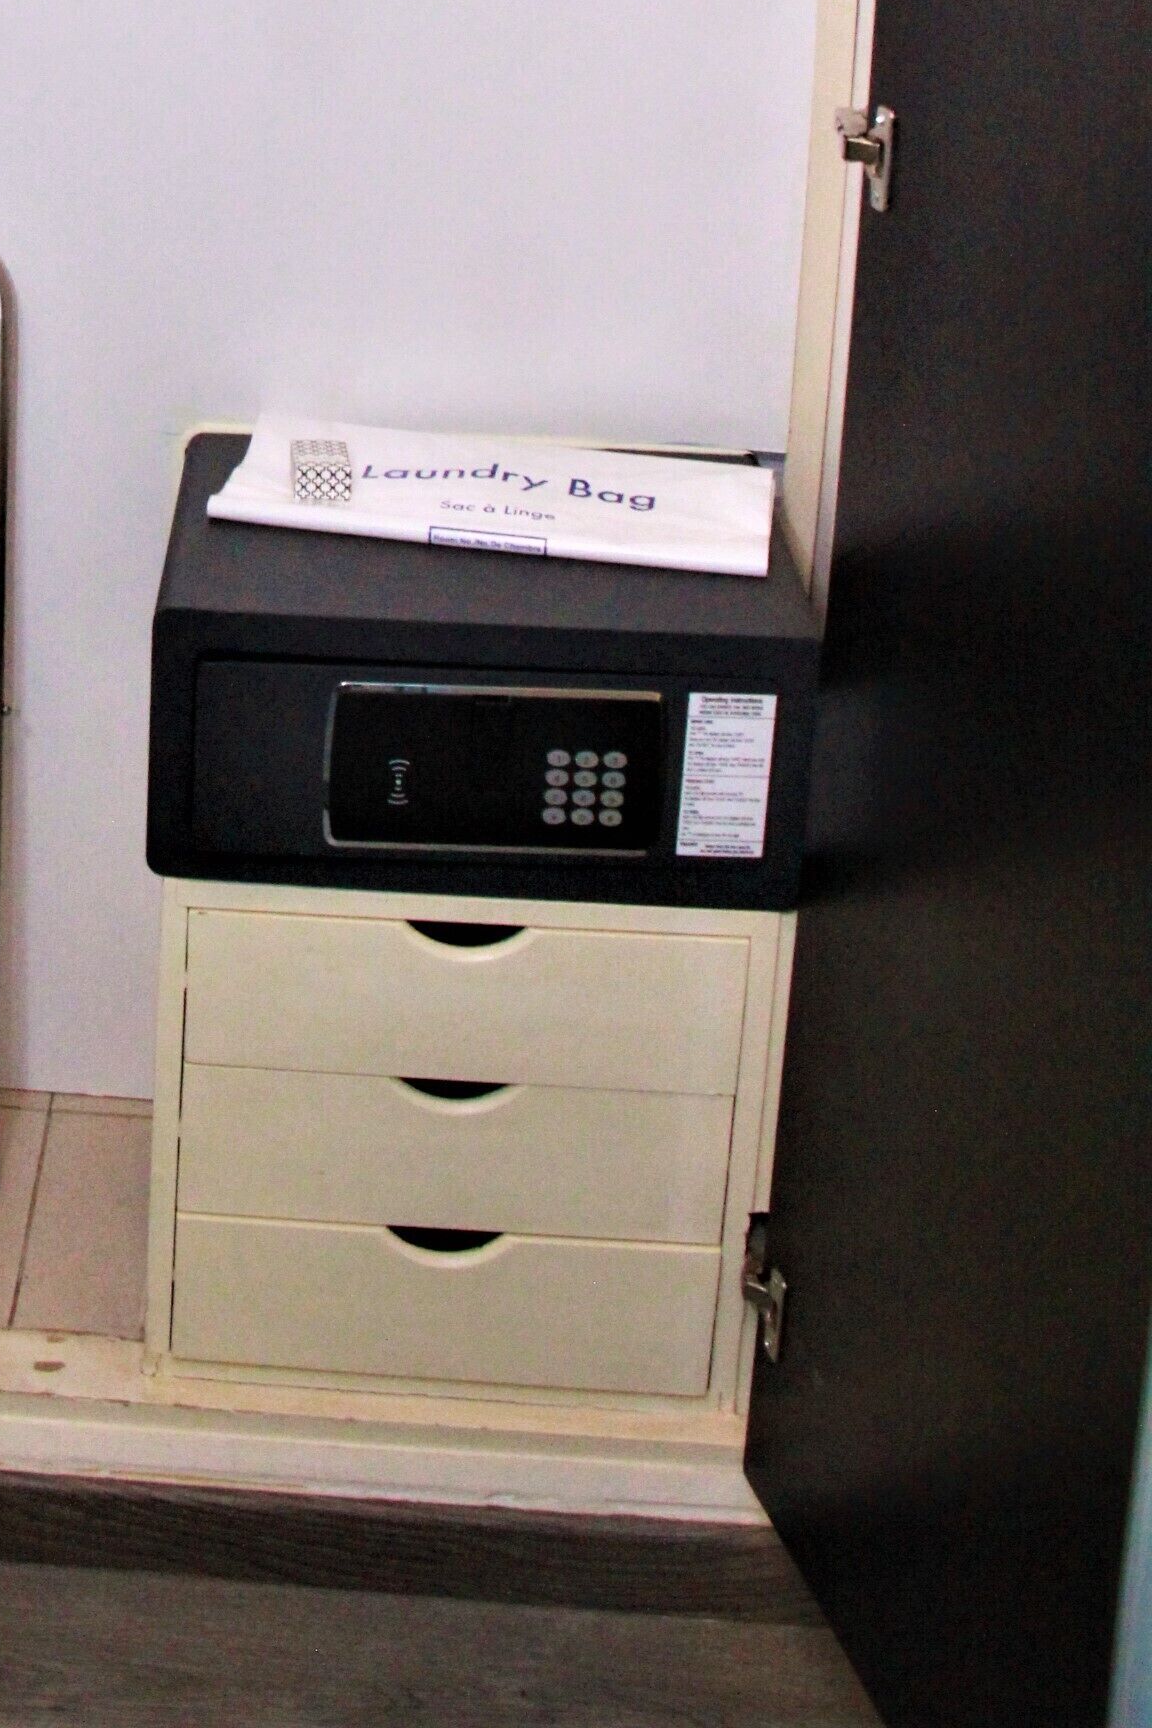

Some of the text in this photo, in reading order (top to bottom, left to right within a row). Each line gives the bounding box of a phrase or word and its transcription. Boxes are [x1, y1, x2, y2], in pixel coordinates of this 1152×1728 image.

[362, 463, 656, 512] Laundry Bag
[440, 500, 555, 521] Sac à Linge
